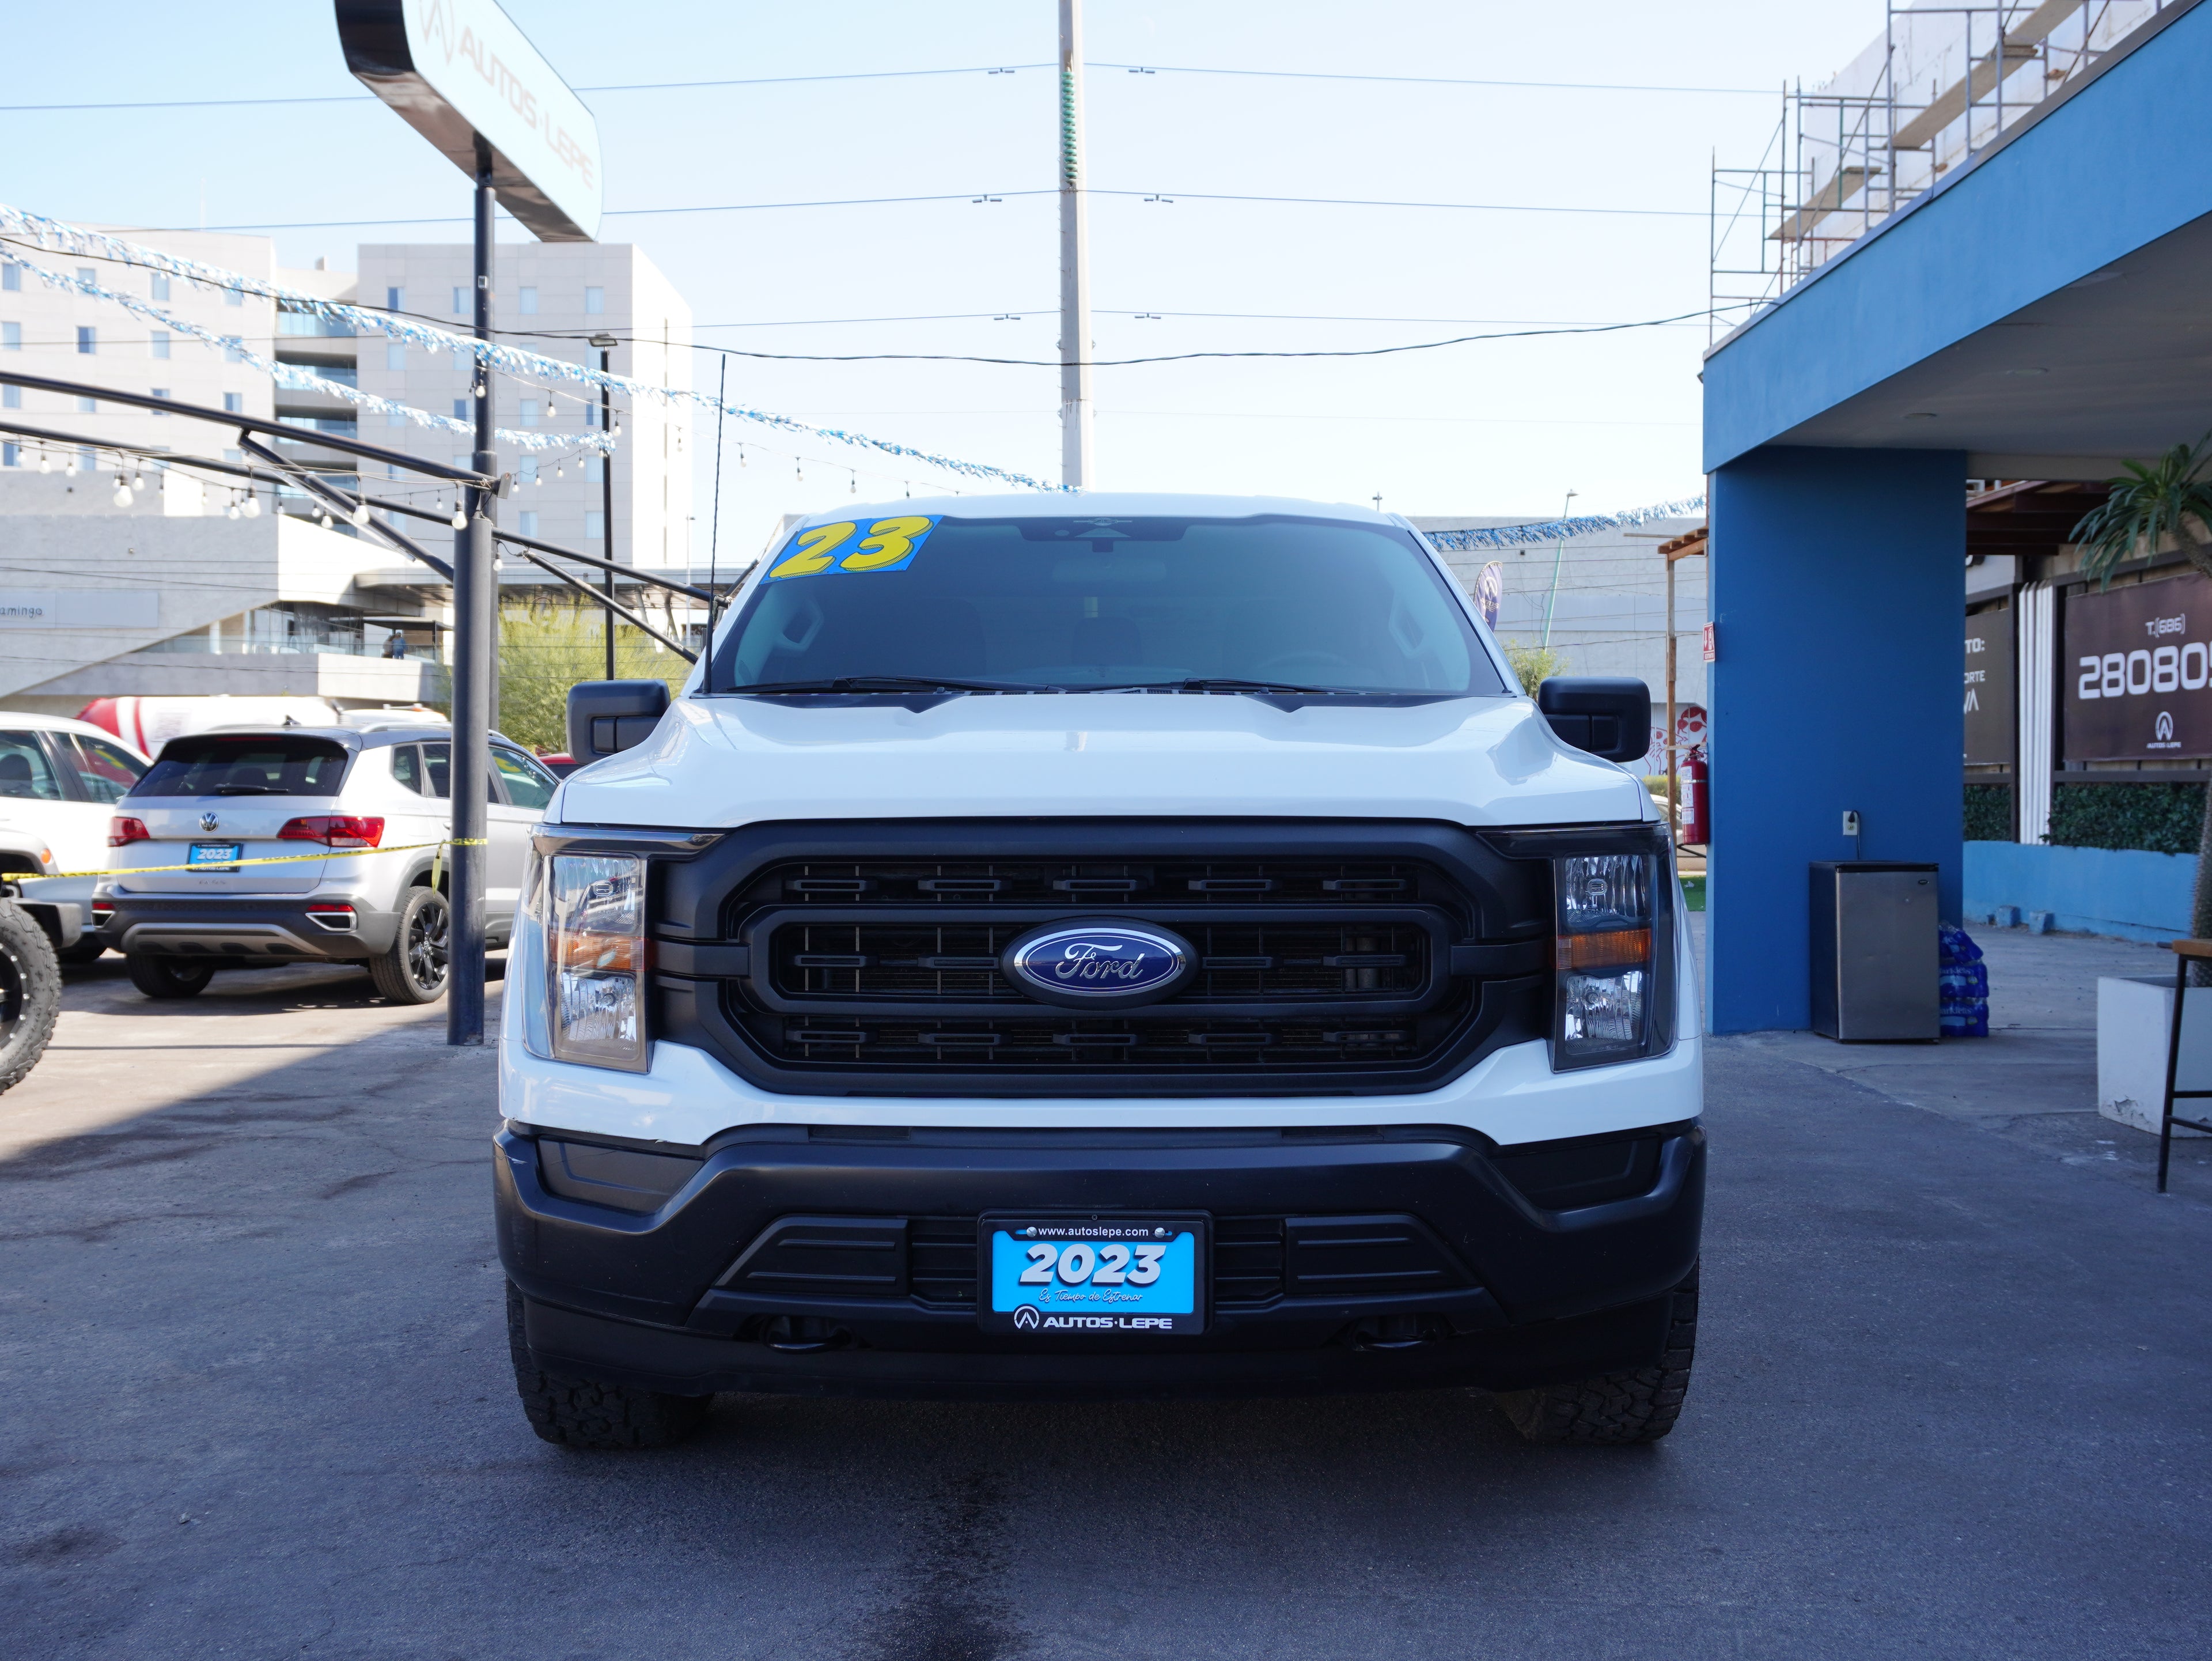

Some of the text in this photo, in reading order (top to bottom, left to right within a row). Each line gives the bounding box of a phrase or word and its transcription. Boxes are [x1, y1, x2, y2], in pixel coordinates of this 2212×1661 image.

[770, 516, 934, 578] 23
[2078, 641, 2212, 699] 28080
[197, 848, 232, 860] 2023
[1055, 943, 1145, 979] Ford
[1038, 1226, 1149, 1238] www.autoslepe.com
[1019, 1243, 1167, 1285] 2023
[1039, 1288, 1143, 1303] Es Tiempo de Estrenar
